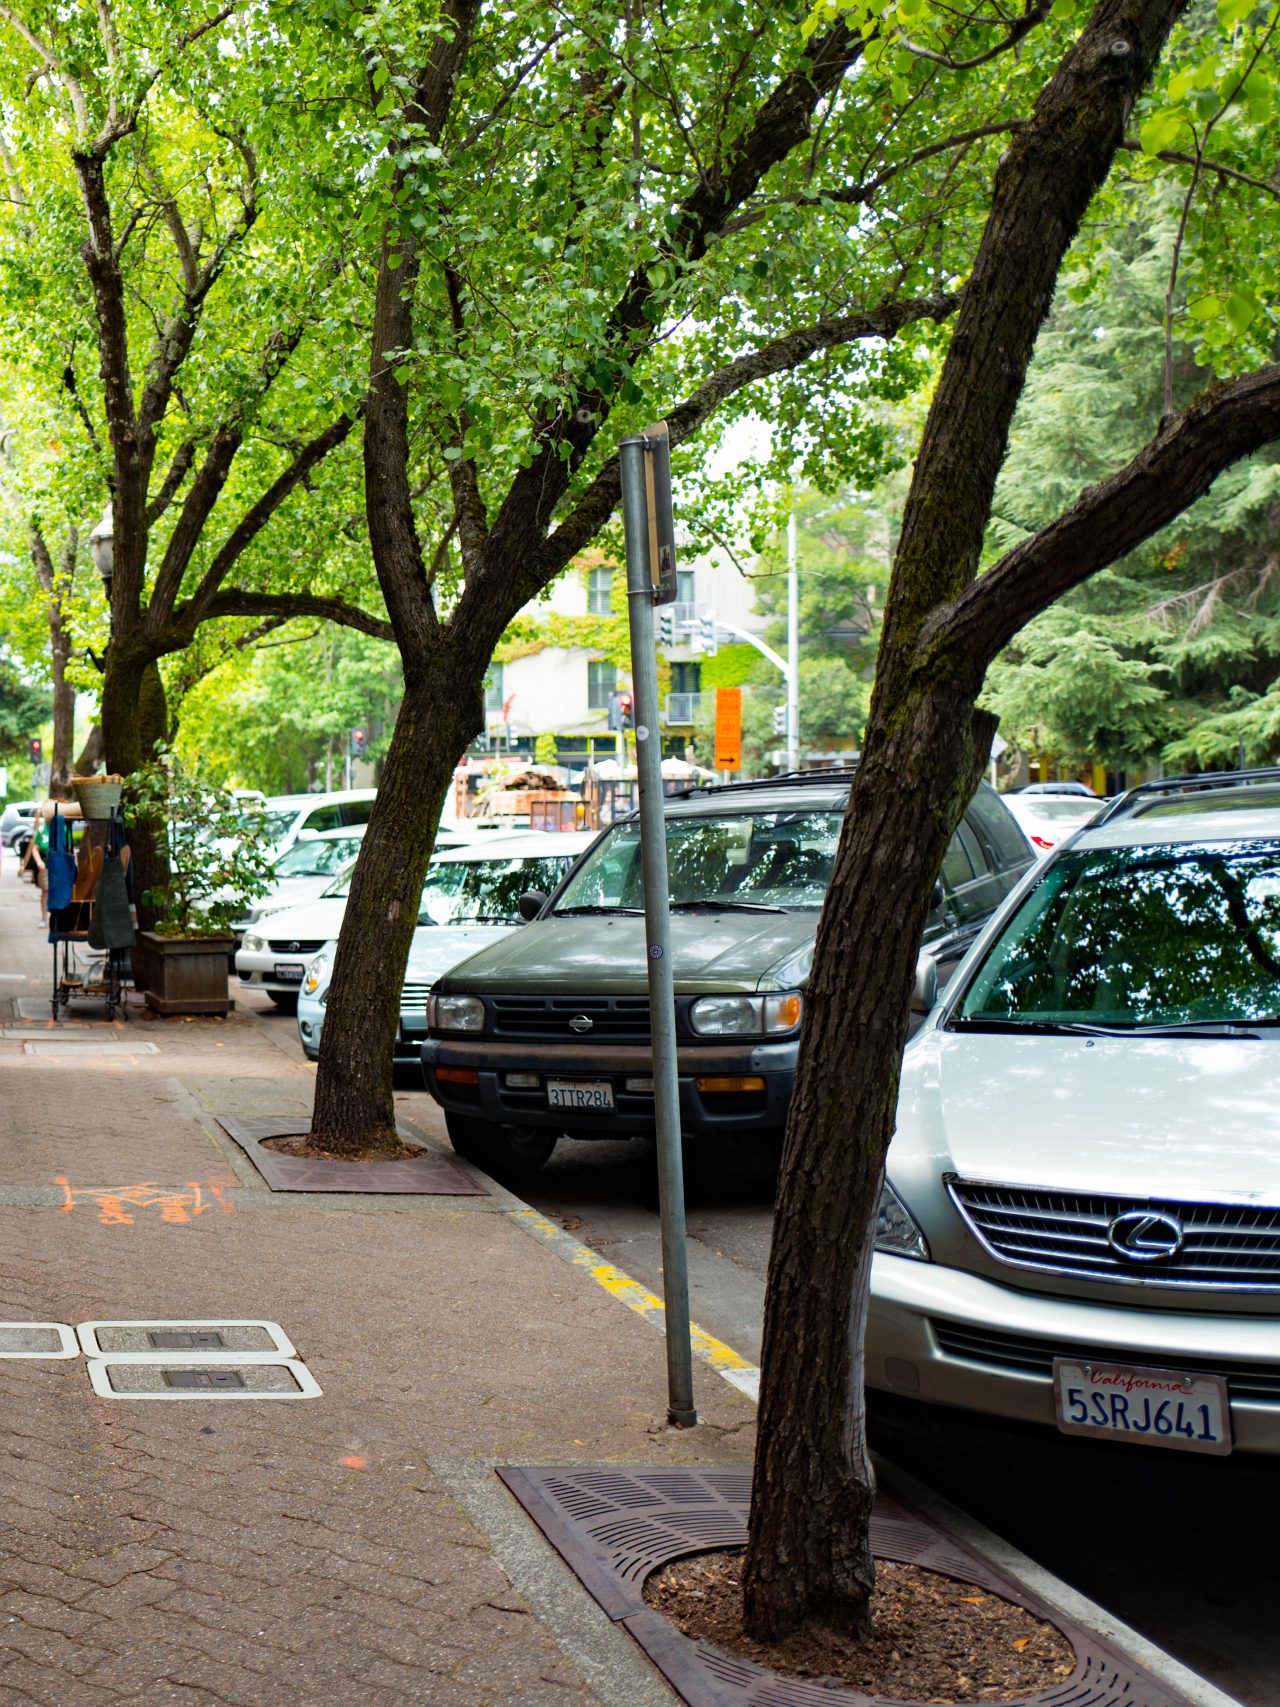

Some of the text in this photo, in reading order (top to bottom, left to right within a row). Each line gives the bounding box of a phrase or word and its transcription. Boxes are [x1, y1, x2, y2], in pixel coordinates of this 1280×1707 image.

[550, 1089, 611, 1108] 3TTR284
[1090, 1369, 1193, 1395] California
[1067, 1388, 1217, 1441] 5SRJ641
